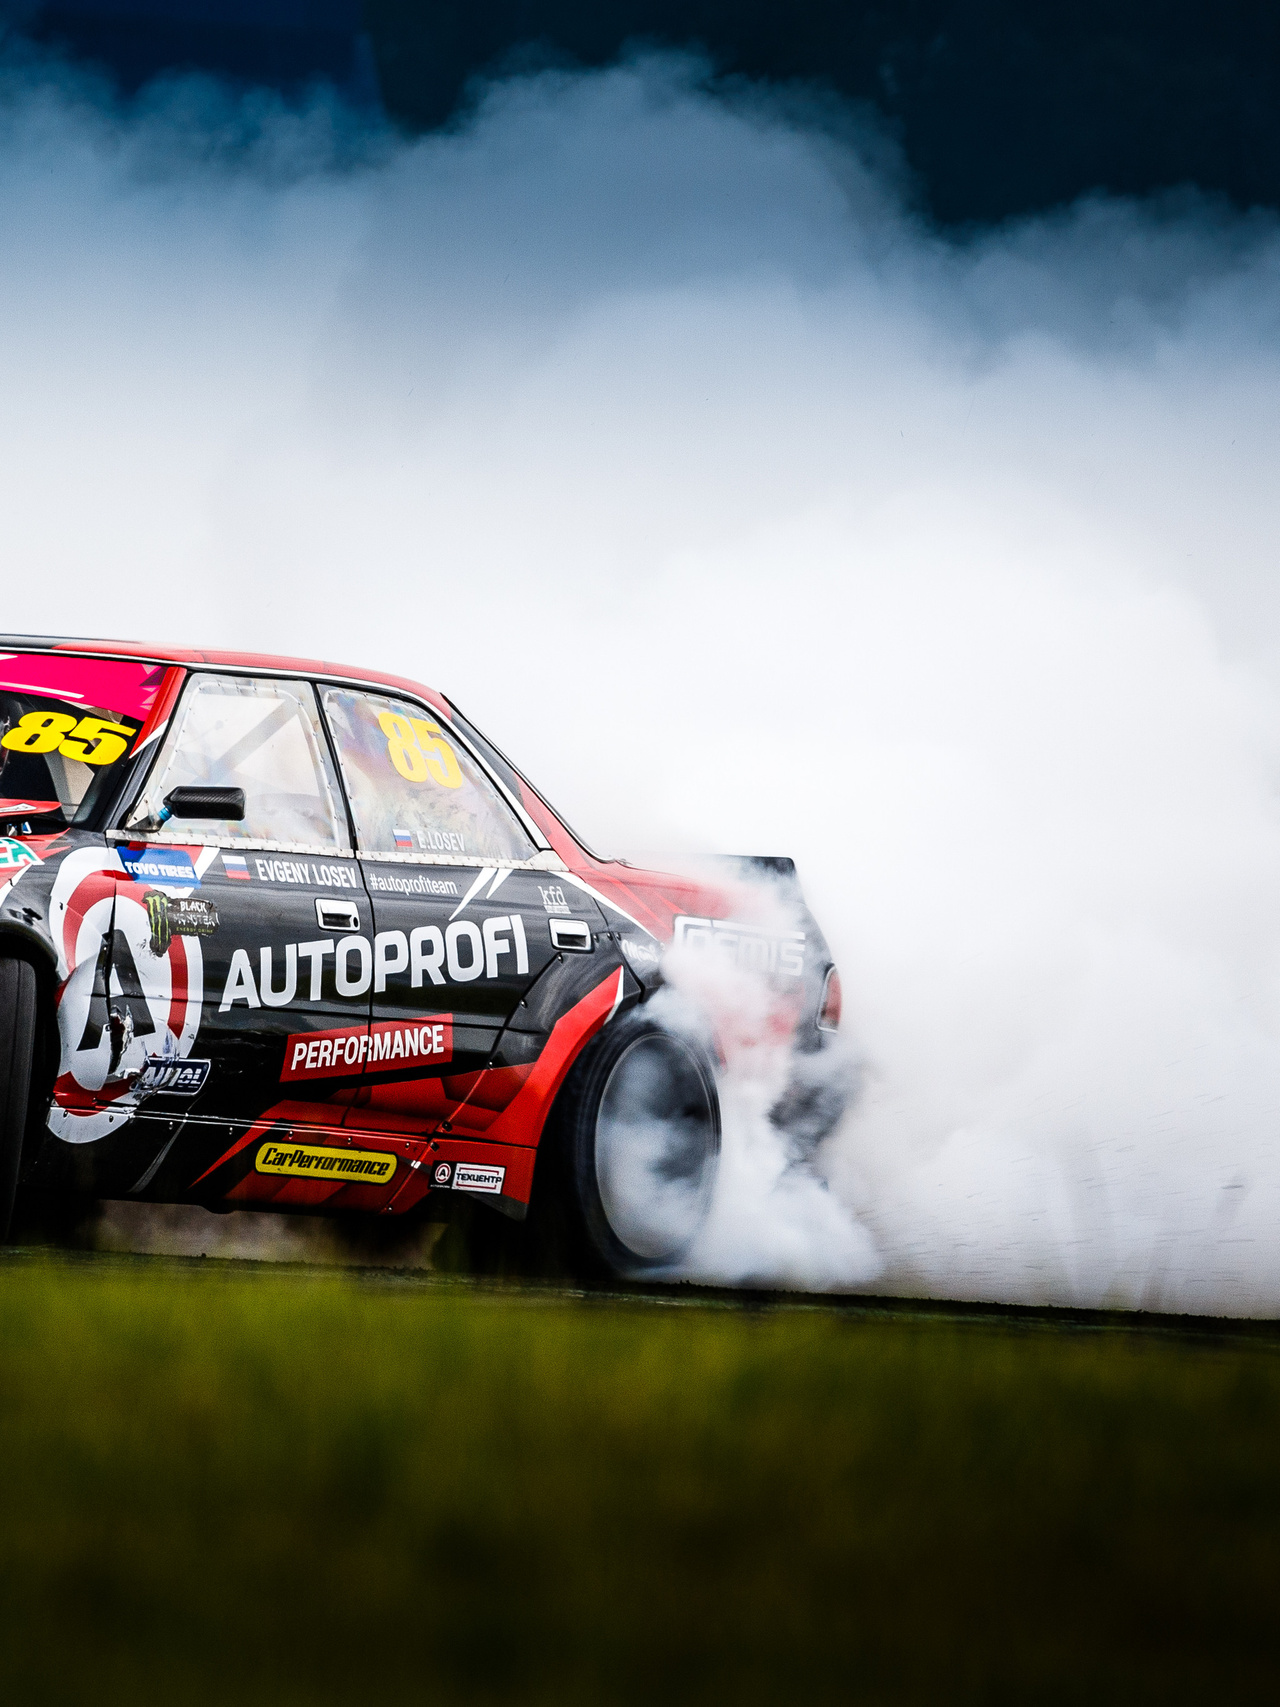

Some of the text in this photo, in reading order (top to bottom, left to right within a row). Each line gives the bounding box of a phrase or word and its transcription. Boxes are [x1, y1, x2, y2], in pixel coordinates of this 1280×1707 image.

[1, 711, 136, 765] 85
[378, 712, 463, 789] 85
[416, 830, 465, 851] E.LOSEV
[125, 862, 195, 878] TOYO TIRES
[255, 859, 357, 888] EVGENY LOSEV
[370, 873, 458, 896] #autoprofiteam
[537, 886, 567, 905] kfd
[180, 901, 206, 912] BLACK
[219, 915, 529, 1012] AUTOPROFI
[291, 1024, 444, 1070] PERFORMANCE
[261, 1147, 391, 1176] CarPerformance
[456, 1172, 503, 1184] ТЕХЦЕНТР
